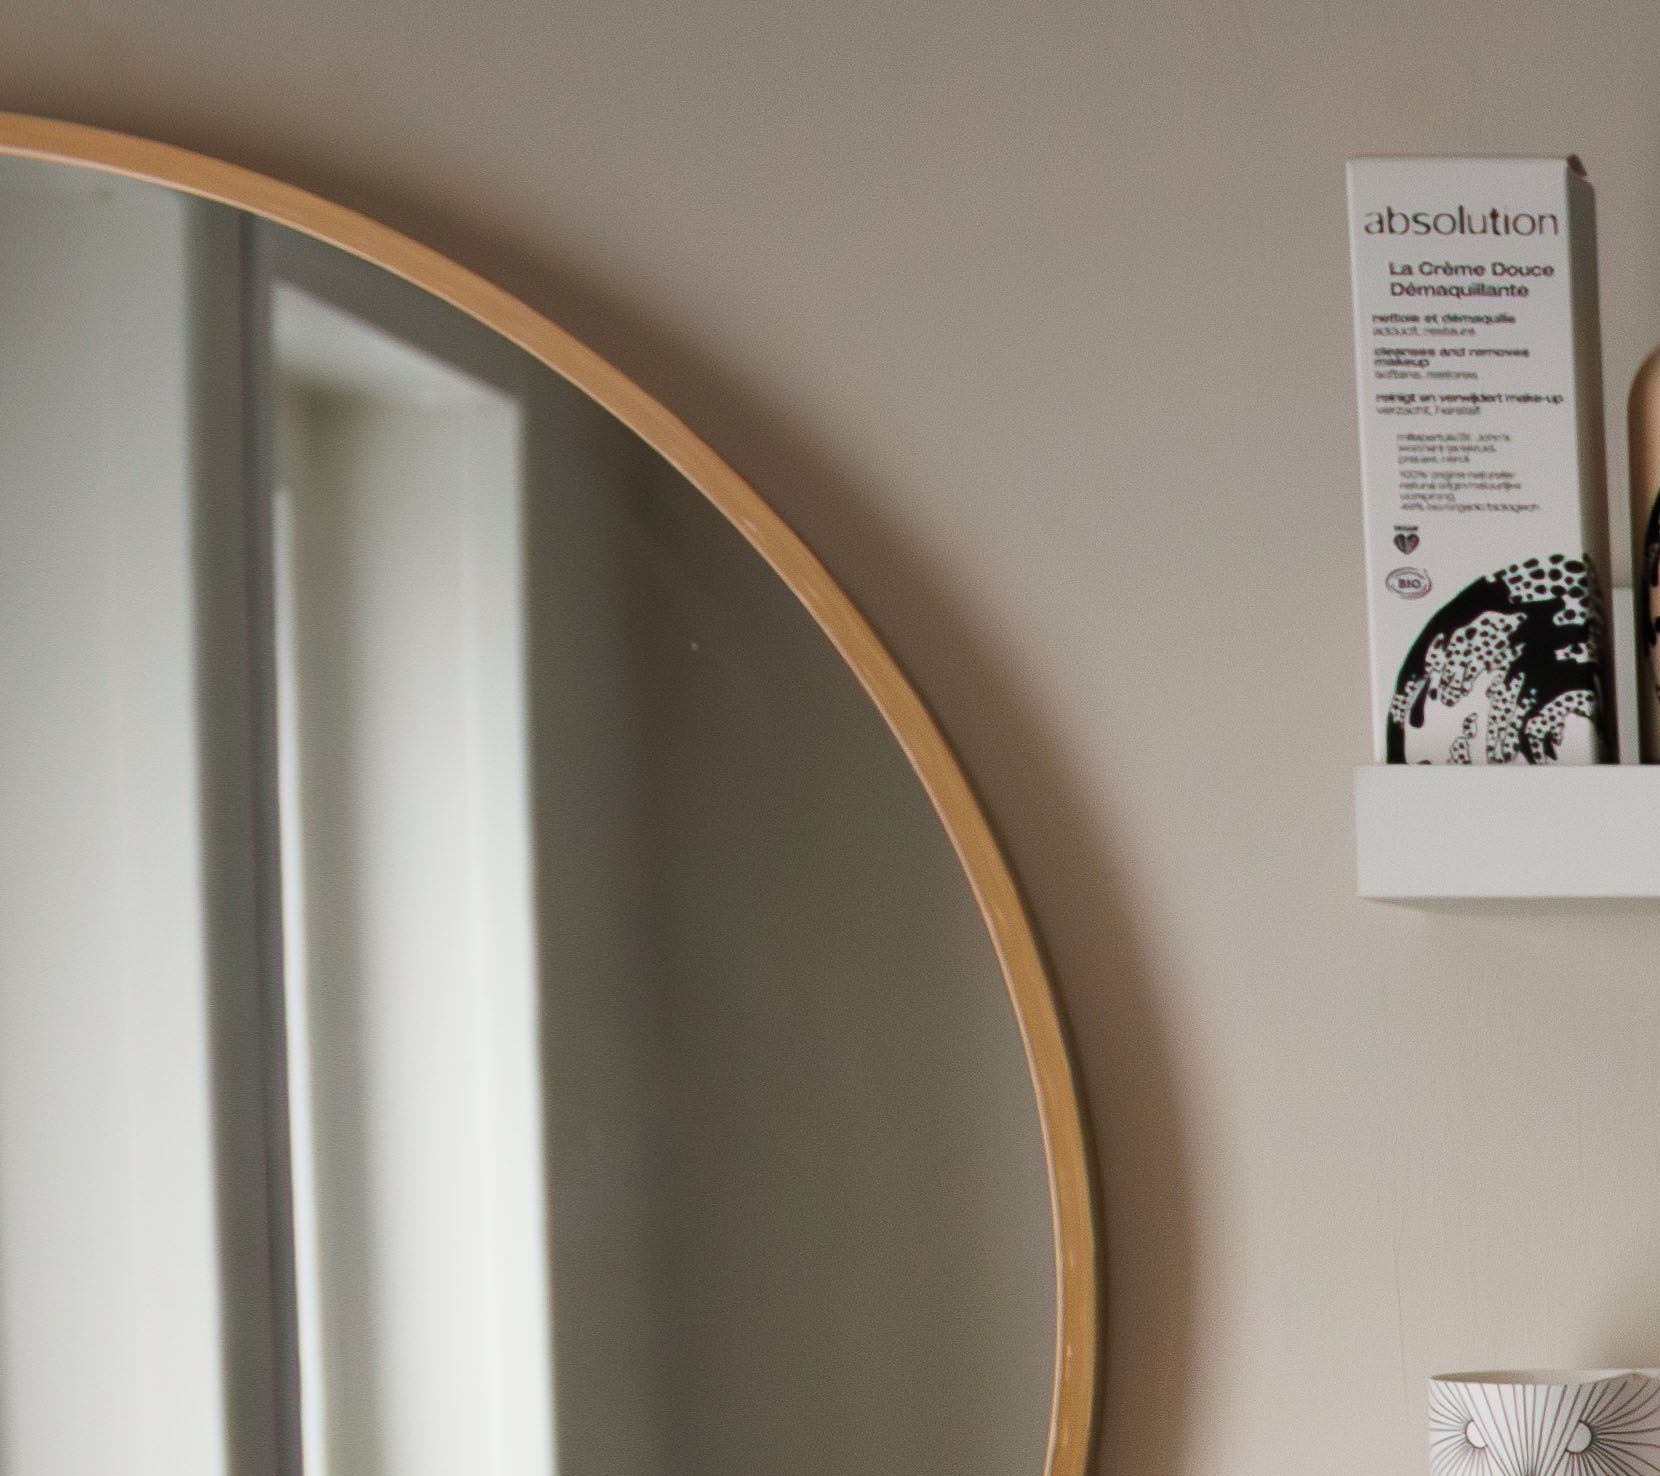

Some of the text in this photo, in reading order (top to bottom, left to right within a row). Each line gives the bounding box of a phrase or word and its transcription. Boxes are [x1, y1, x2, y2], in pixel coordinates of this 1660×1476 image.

[1364, 204, 1559, 236] absolution
[1389, 261, 1555, 276] La Crème Douce
[1389, 281, 1529, 299] Démaquillante
